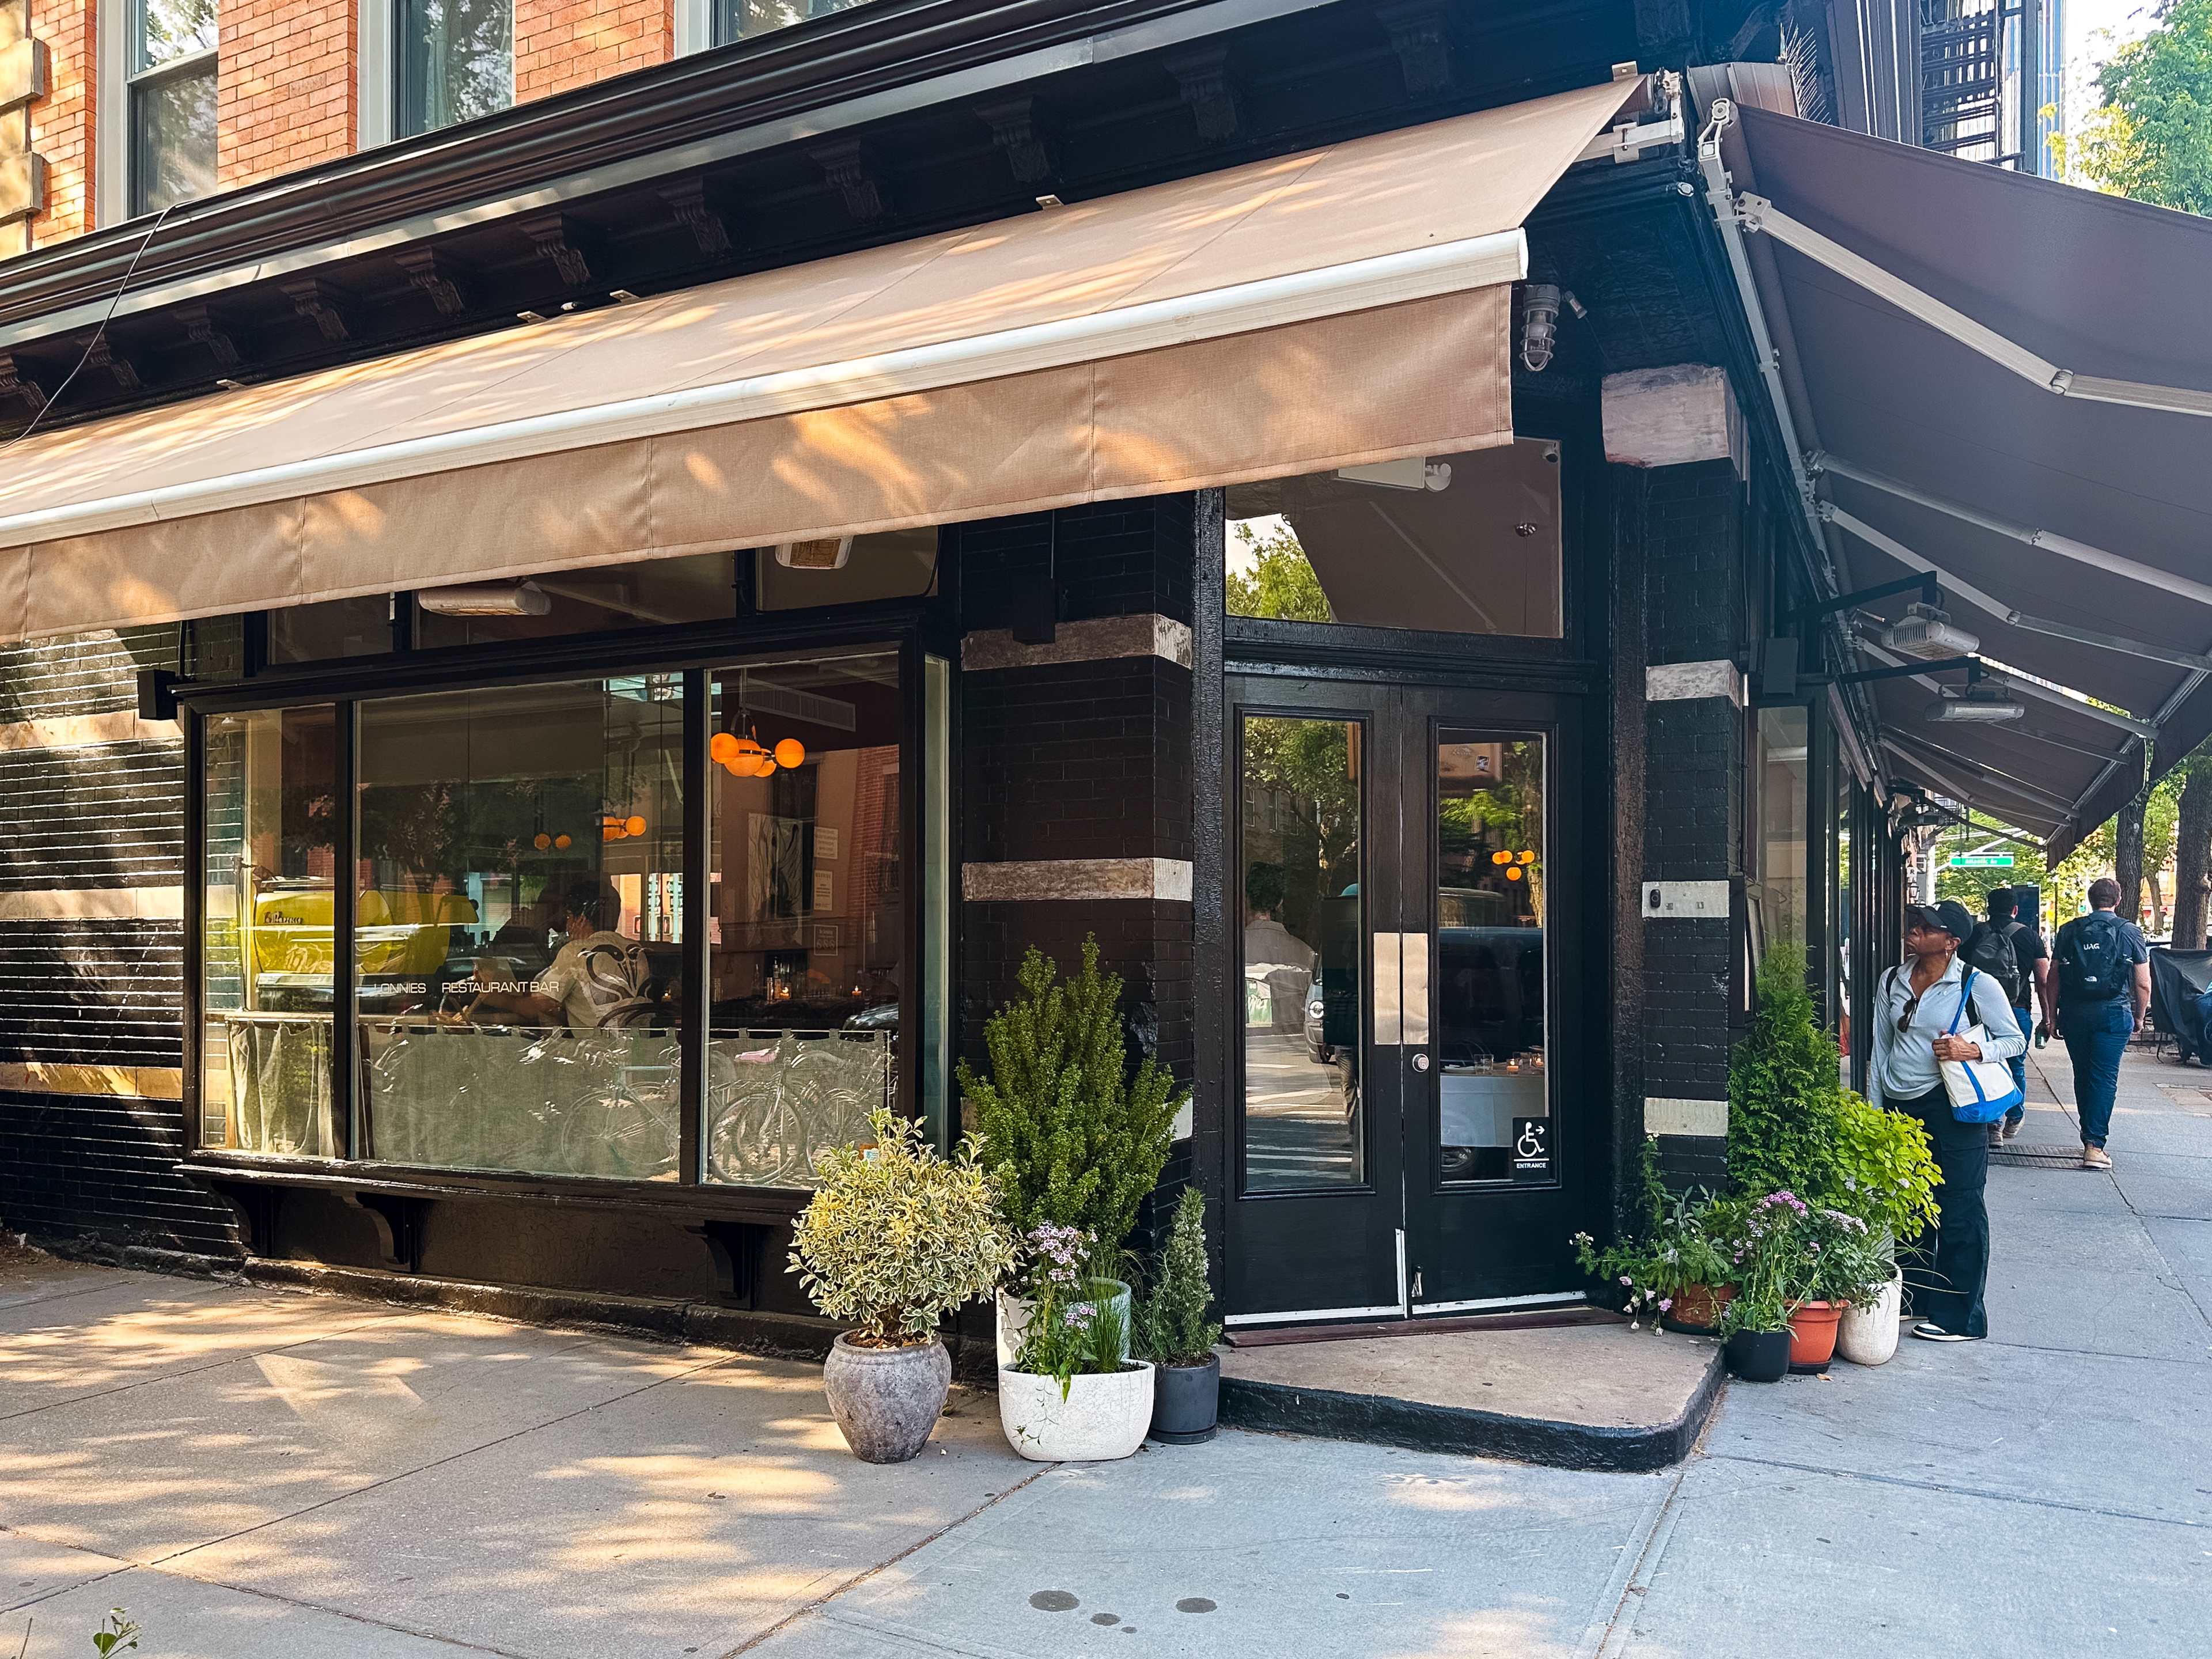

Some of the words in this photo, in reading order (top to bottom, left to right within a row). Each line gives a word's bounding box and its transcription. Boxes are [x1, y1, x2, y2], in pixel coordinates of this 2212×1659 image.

[2083, 942, 2100, 950] UAG
[442, 982, 528, 993] RESTAURANT
[530, 981, 559, 992] BAR
